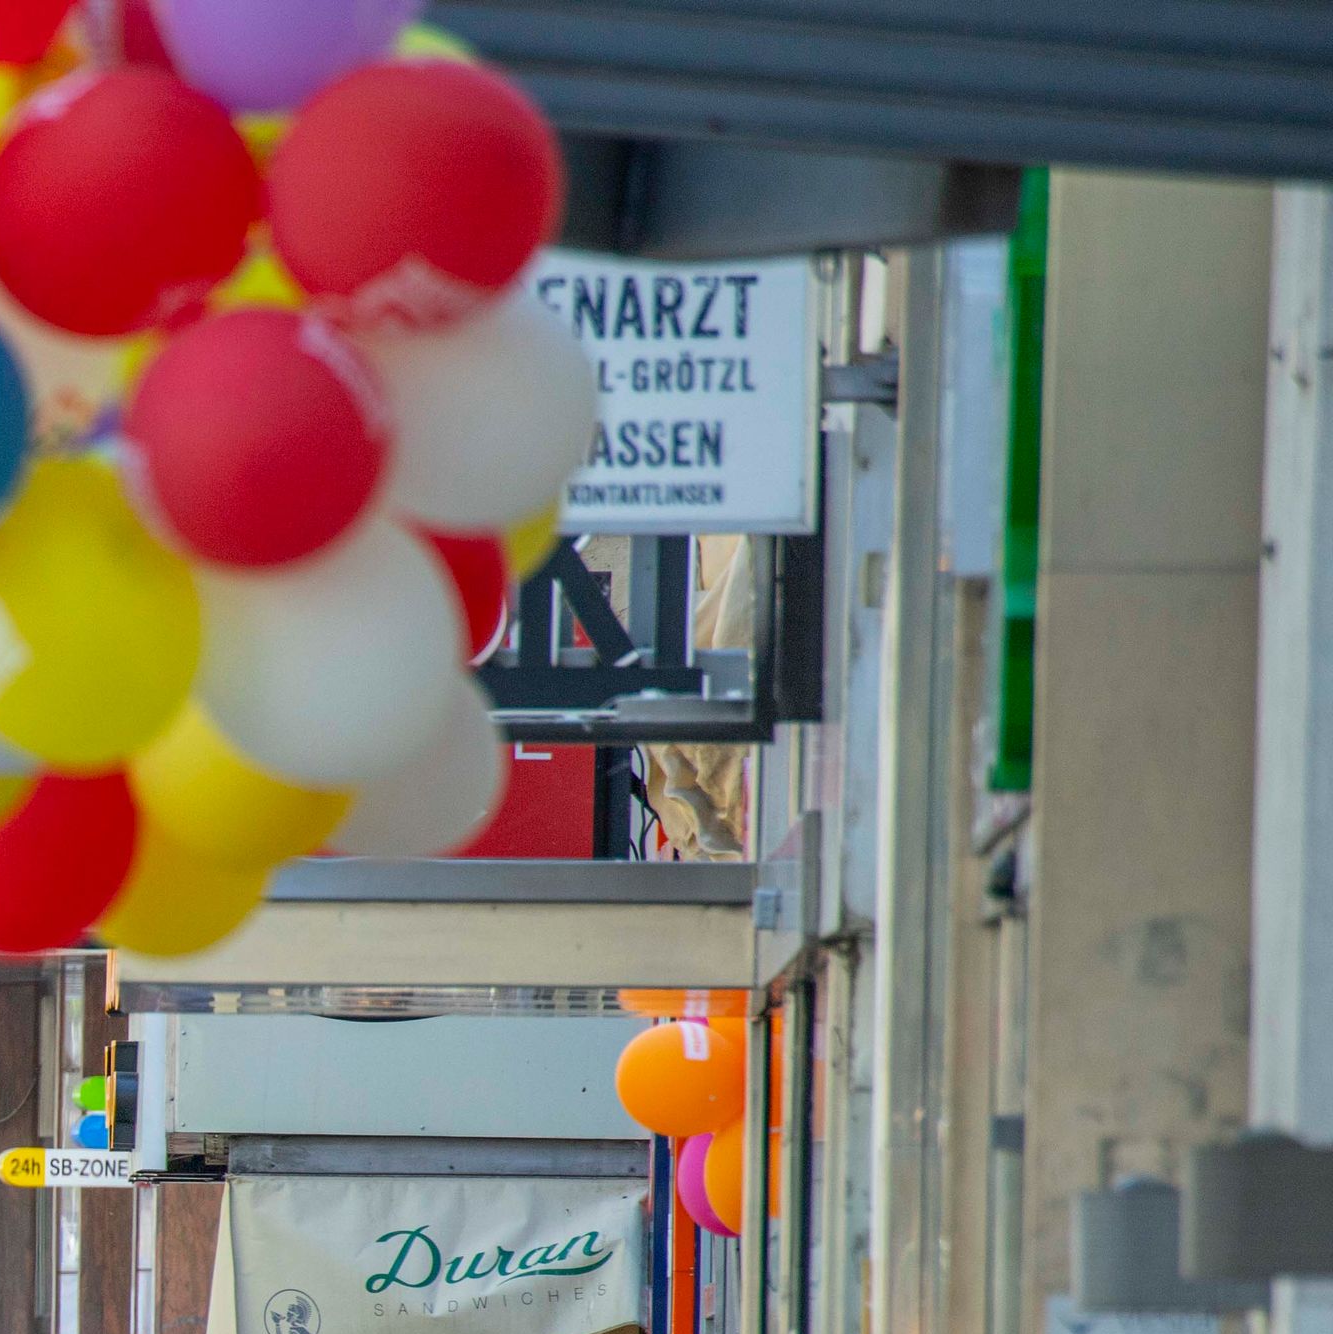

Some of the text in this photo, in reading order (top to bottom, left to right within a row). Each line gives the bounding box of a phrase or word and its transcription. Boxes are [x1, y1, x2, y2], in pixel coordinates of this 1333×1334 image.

[598, 351, 756, 393] L-GRÖTZL
[588, 421, 724, 467] ASSEN
[567, 482, 724, 506] KONTAKTLINSEN
[11, 1158, 128, 1177] 24h SB-ZONE
[365, 1225, 613, 1294] Duran
[373, 1283, 608, 1318] SANDWICHES
